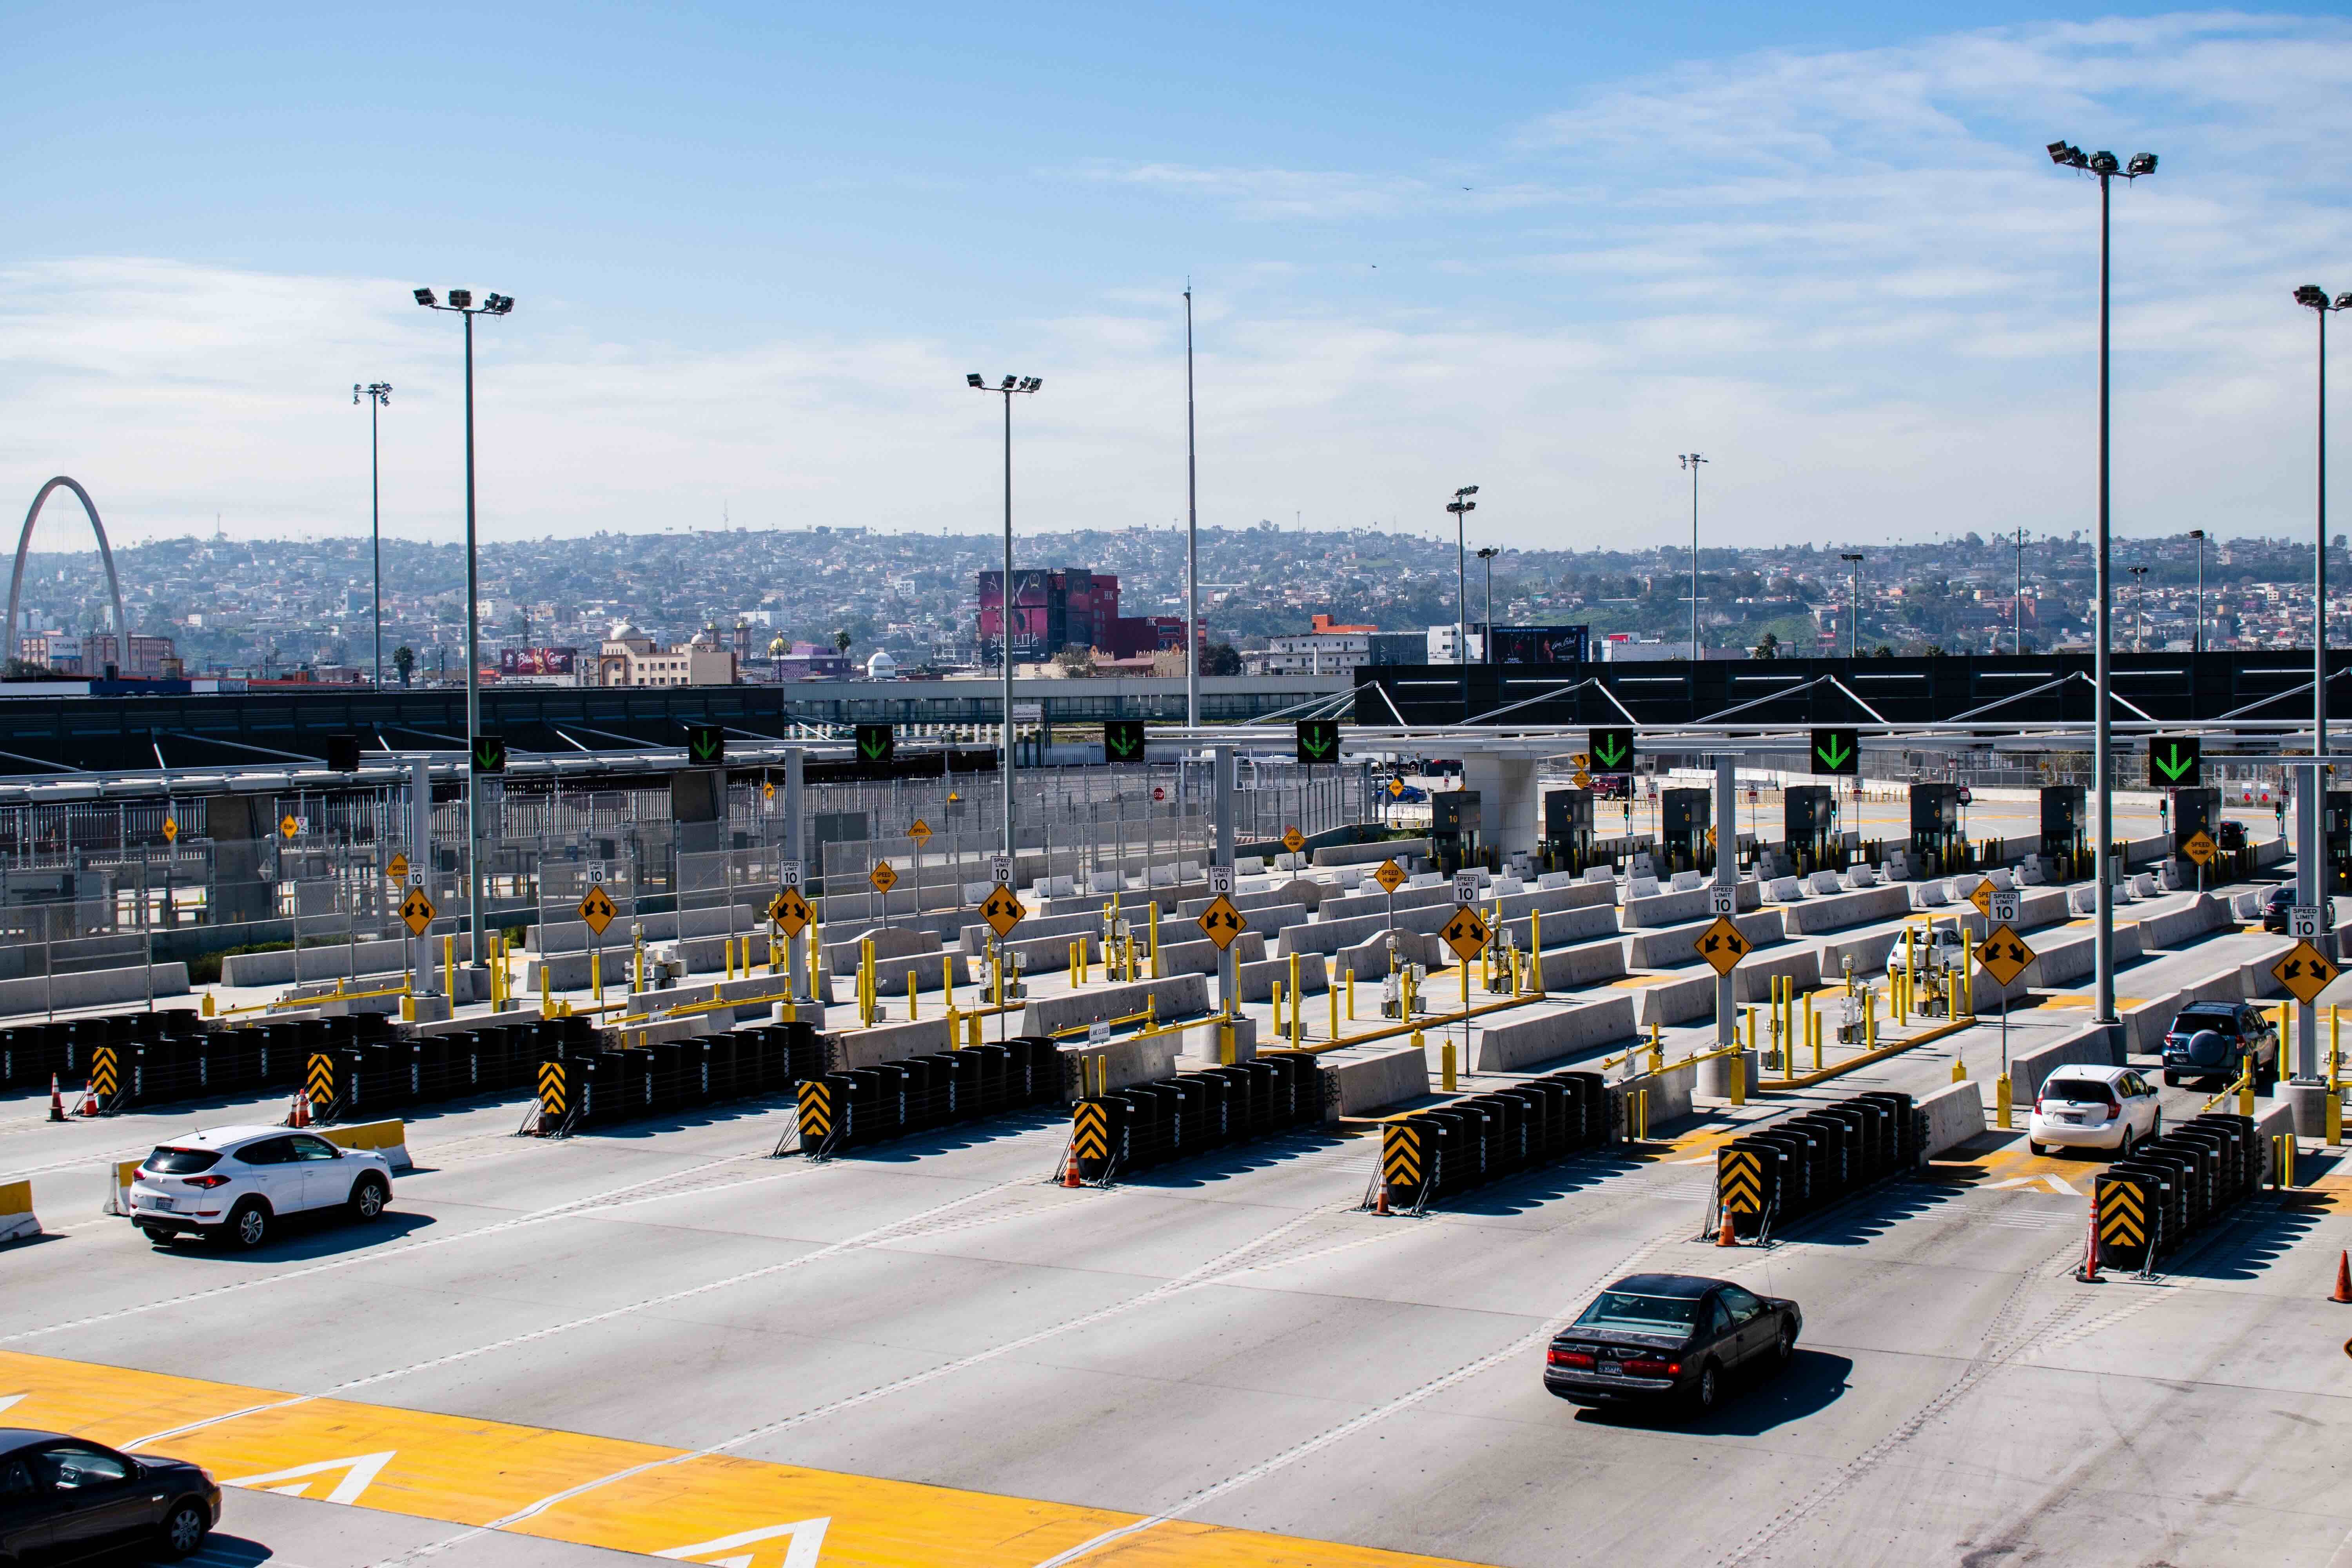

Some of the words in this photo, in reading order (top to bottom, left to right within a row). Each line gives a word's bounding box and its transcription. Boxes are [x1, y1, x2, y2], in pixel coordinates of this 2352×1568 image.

[1104, 591, 1114, 600] HK
[1146, 618, 1157, 626] HK
[988, 632, 1040, 645] ADLITA
[1567, 814, 1572, 822] 9
[1685, 813, 1690, 822] 8
[1808, 811, 1813, 819] 7
[1935, 809, 1940, 818] 6
[2066, 812, 2071, 821] 5
[2200, 815, 2206, 824] 4
[2343, 818, 2348, 828] 3
[412, 874, 422, 884] 10
[590, 871, 602, 882] 10
[785, 872, 797, 884] 10
[996, 869, 1009, 880] 10
[1214, 879, 1228, 891] 10
[1458, 888, 1473, 900] 10
[1715, 899, 1731, 912] 10
[1996, 906, 2014, 920] 10
[2296, 921, 2315, 936] 10
